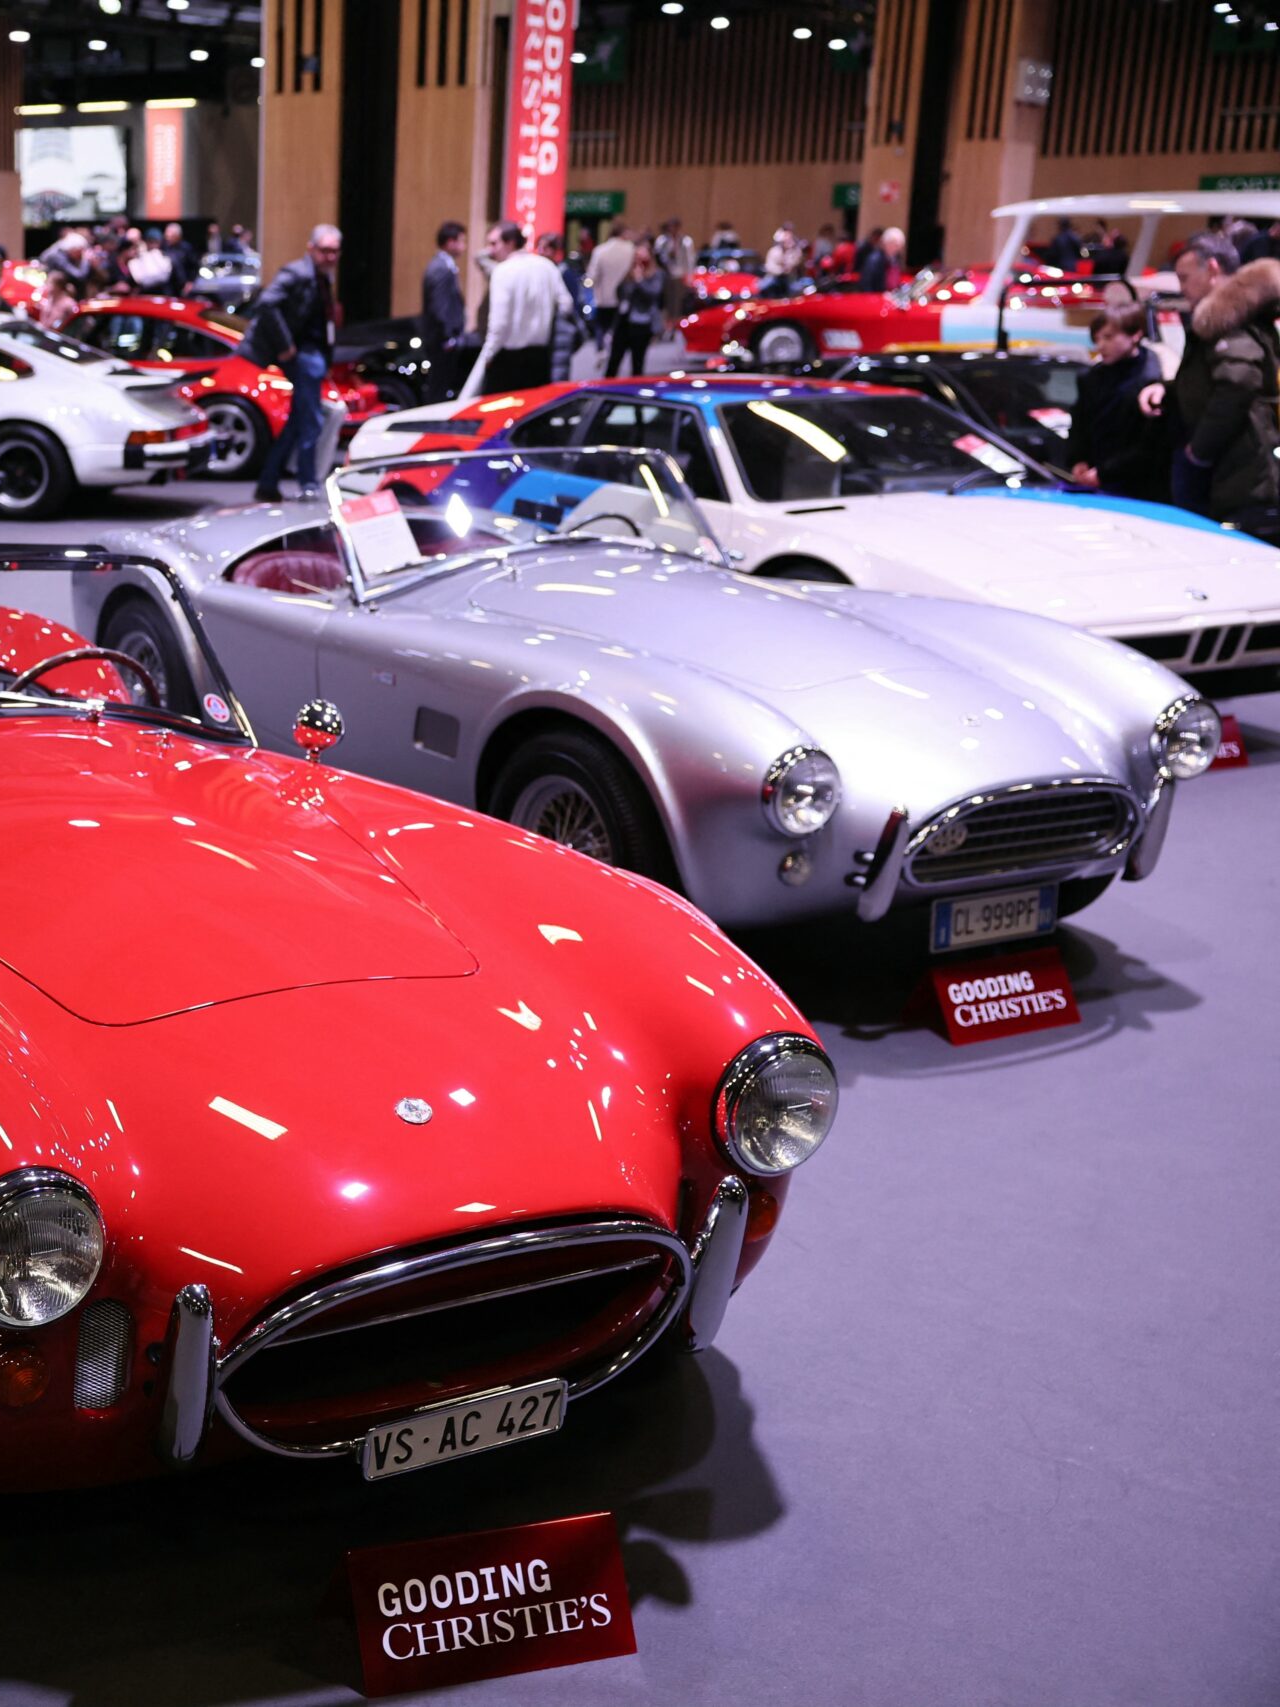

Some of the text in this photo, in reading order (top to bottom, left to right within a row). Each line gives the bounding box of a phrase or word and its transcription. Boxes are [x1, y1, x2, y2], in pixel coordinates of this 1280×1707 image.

[947, 970, 1035, 1005] GOODING
[954, 988, 1067, 1028] CHRISTIE'S
[496, 1388, 562, 1437] 427
[377, 1558, 552, 1618] GOODING
[382, 1592, 612, 1660] CHRISTIE'S
